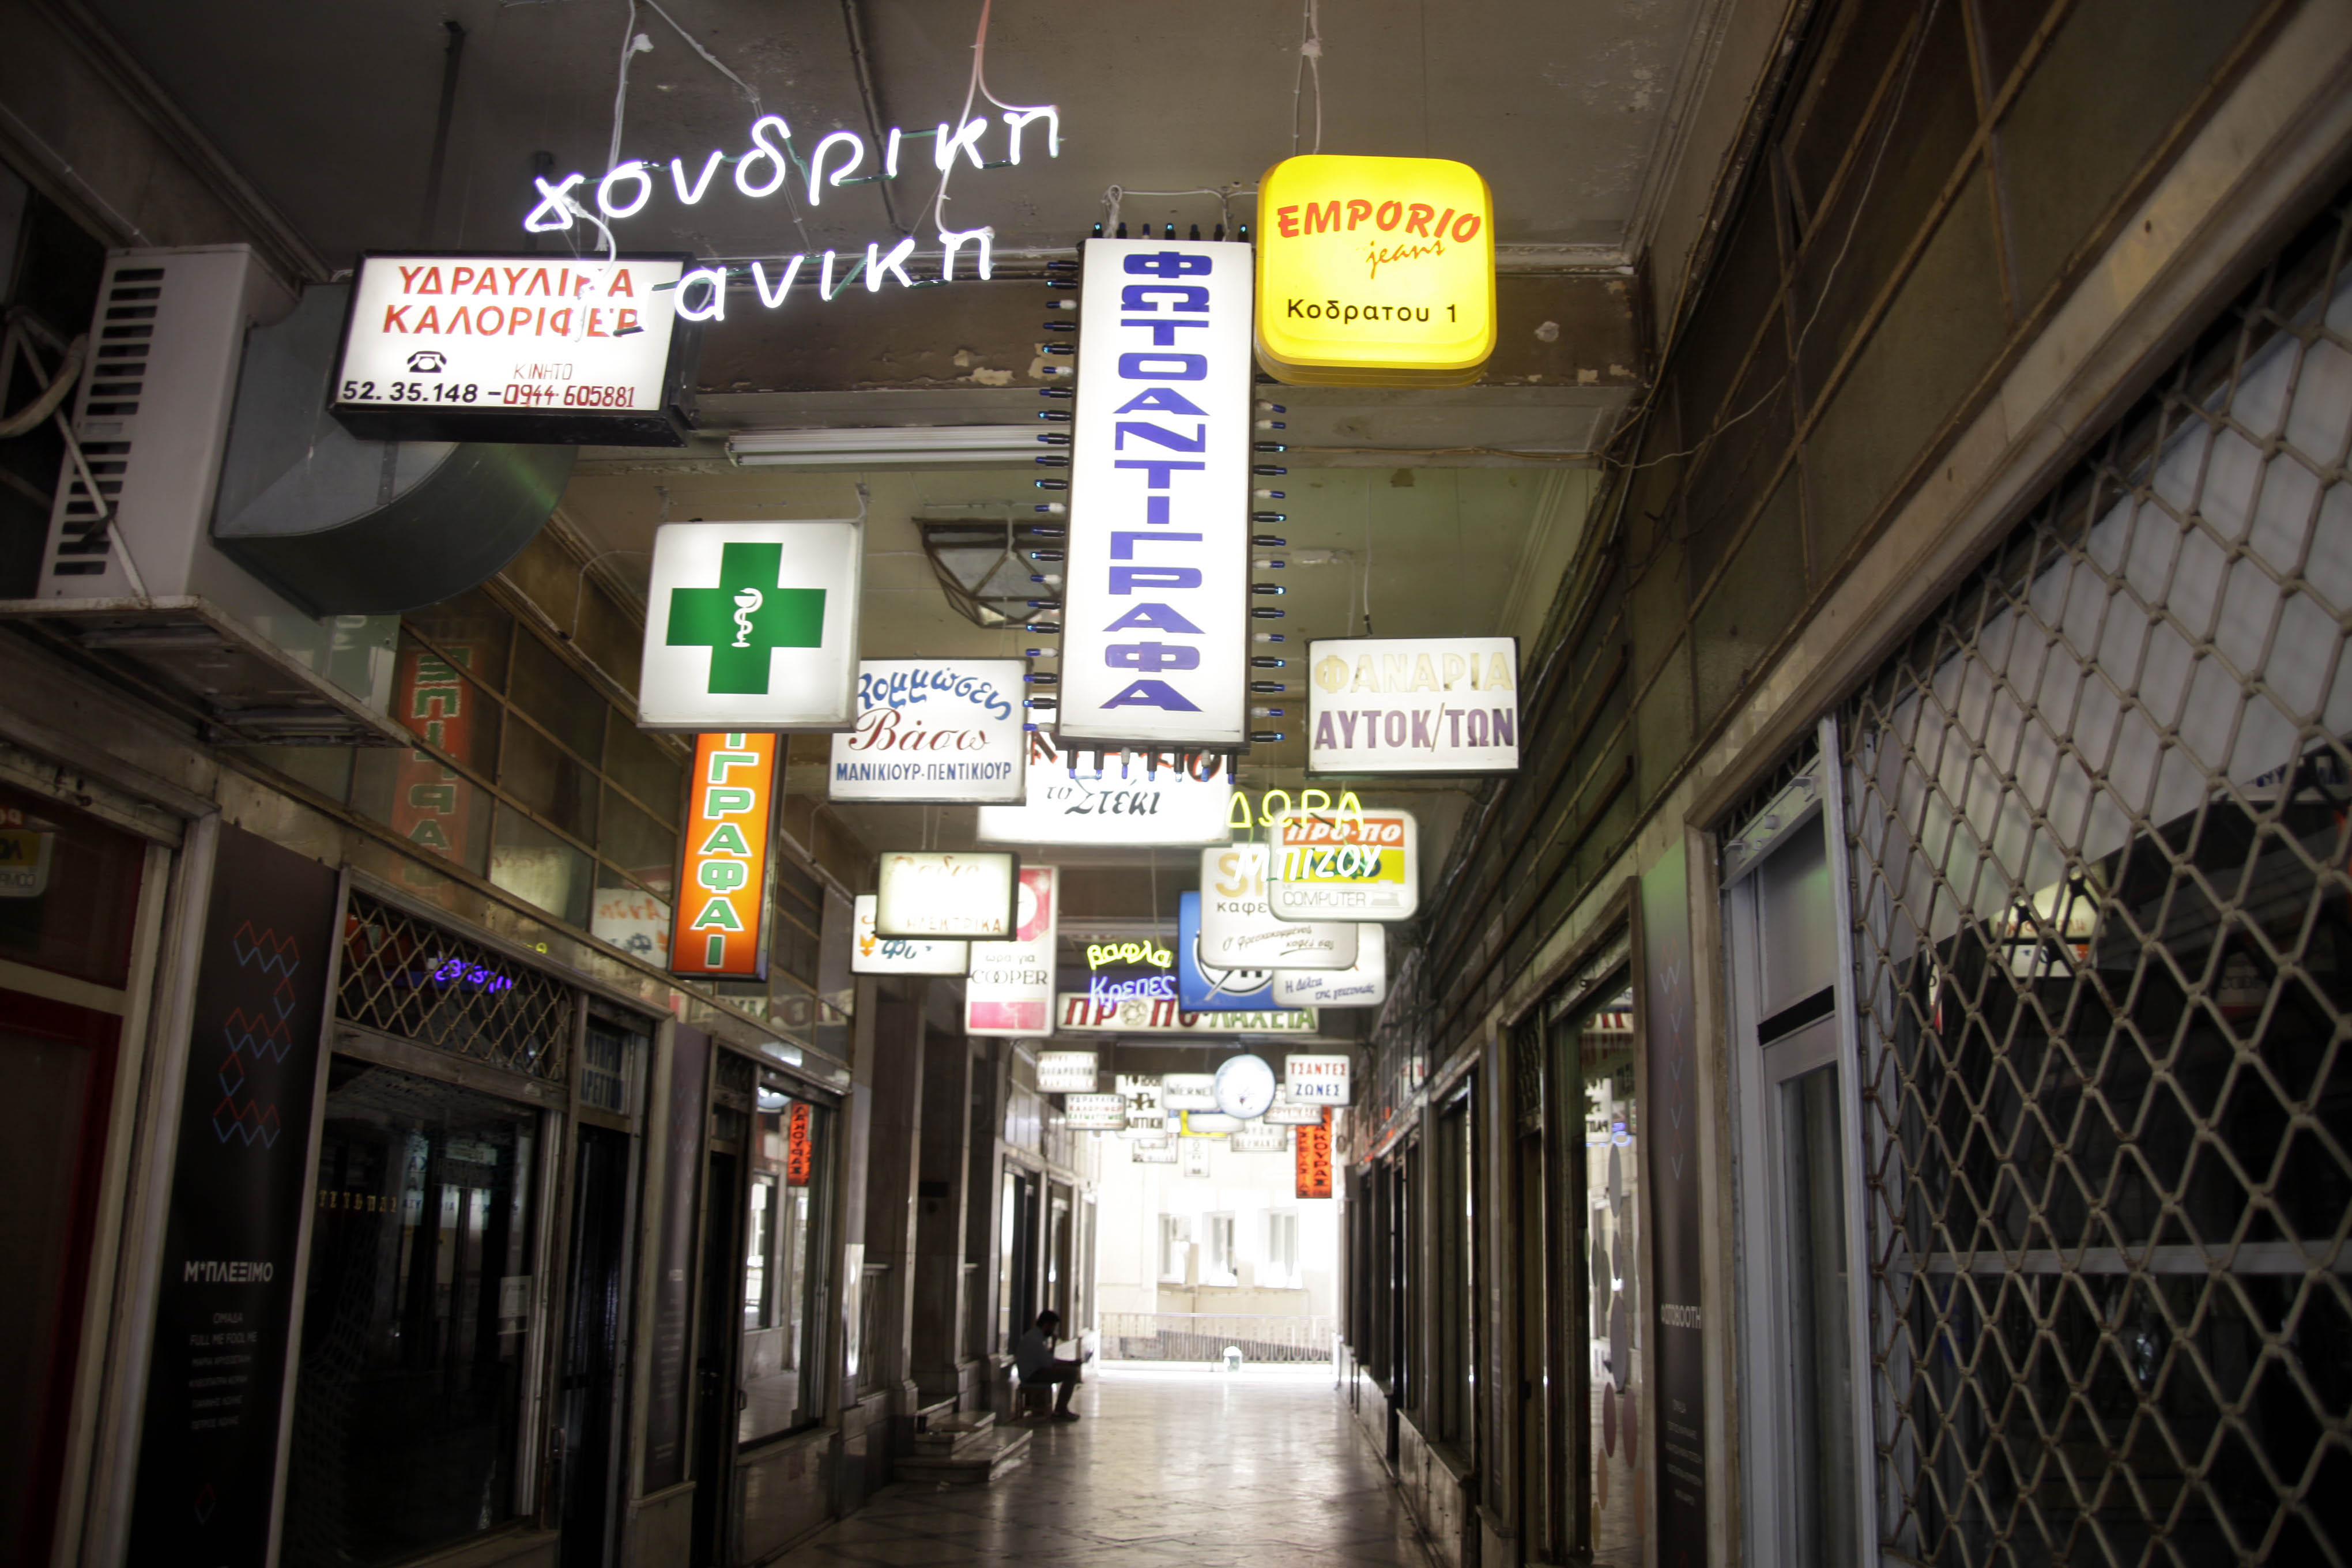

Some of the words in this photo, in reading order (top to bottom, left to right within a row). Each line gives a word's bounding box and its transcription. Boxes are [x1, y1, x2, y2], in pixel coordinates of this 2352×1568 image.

[1277, 199, 1481, 243] EMPORIO
[1365, 240, 1445, 280] jeans
[1287, 299, 1430, 325] Κοδρατου
[1446, 304, 1456, 323] 1
[512, 363, 573, 380] ΚΙΝΗΤΟ
[342, 380, 478, 403] 52.35.148
[564, 385, 635, 407] 605881
[1099, 251, 1213, 713] ΦΩΤΟΑΝΤΙΓΡΑΦΑ
[1315, 652, 1514, 694] ΦΑΝΑΡΙΑ
[848, 708, 990, 751] Βάσω
[1314, 702, 1514, 753] ΑΥΤΟΚ/ΤΩΝ
[1226, 789, 1365, 830] ΔΩΡΑ
[1234, 844, 1382, 883] ΜΠΙΖΟΥ
[1282, 891, 1366, 906] COMPUTER
[971, 969, 1047, 985] COOPER
[1290, 1062, 1347, 1076] ΤΣΑΝΤΕΣ
[1295, 1083, 1340, 1096] ΖΩΝΕΣ
